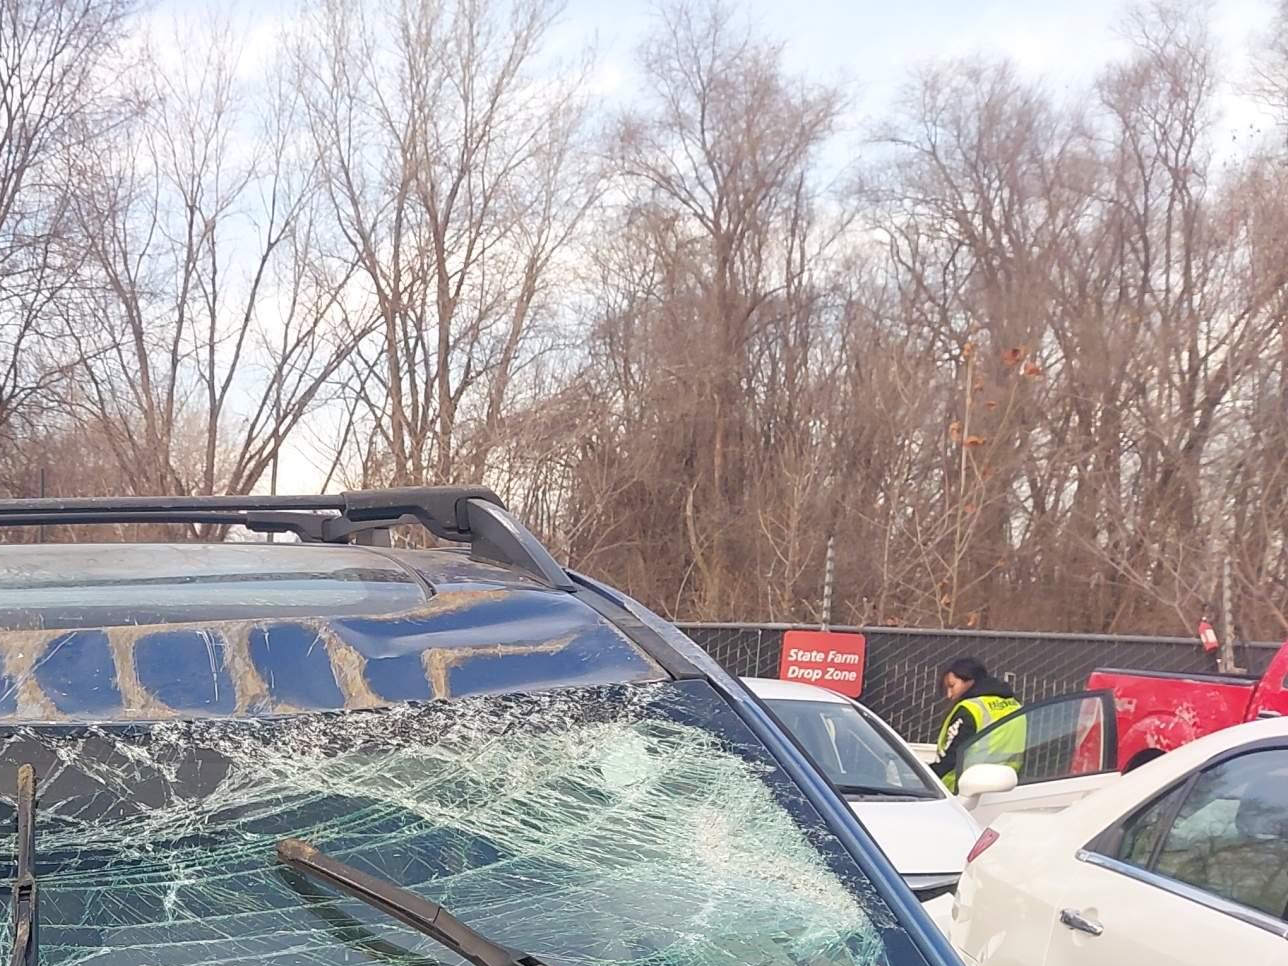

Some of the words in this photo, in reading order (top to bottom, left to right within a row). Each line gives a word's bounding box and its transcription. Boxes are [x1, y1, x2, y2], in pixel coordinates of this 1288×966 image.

[787, 648, 825, 663] State
[827, 650, 859, 664] Farm
[787, 666, 822, 682] Drop
[824, 667, 857, 681] Zone
